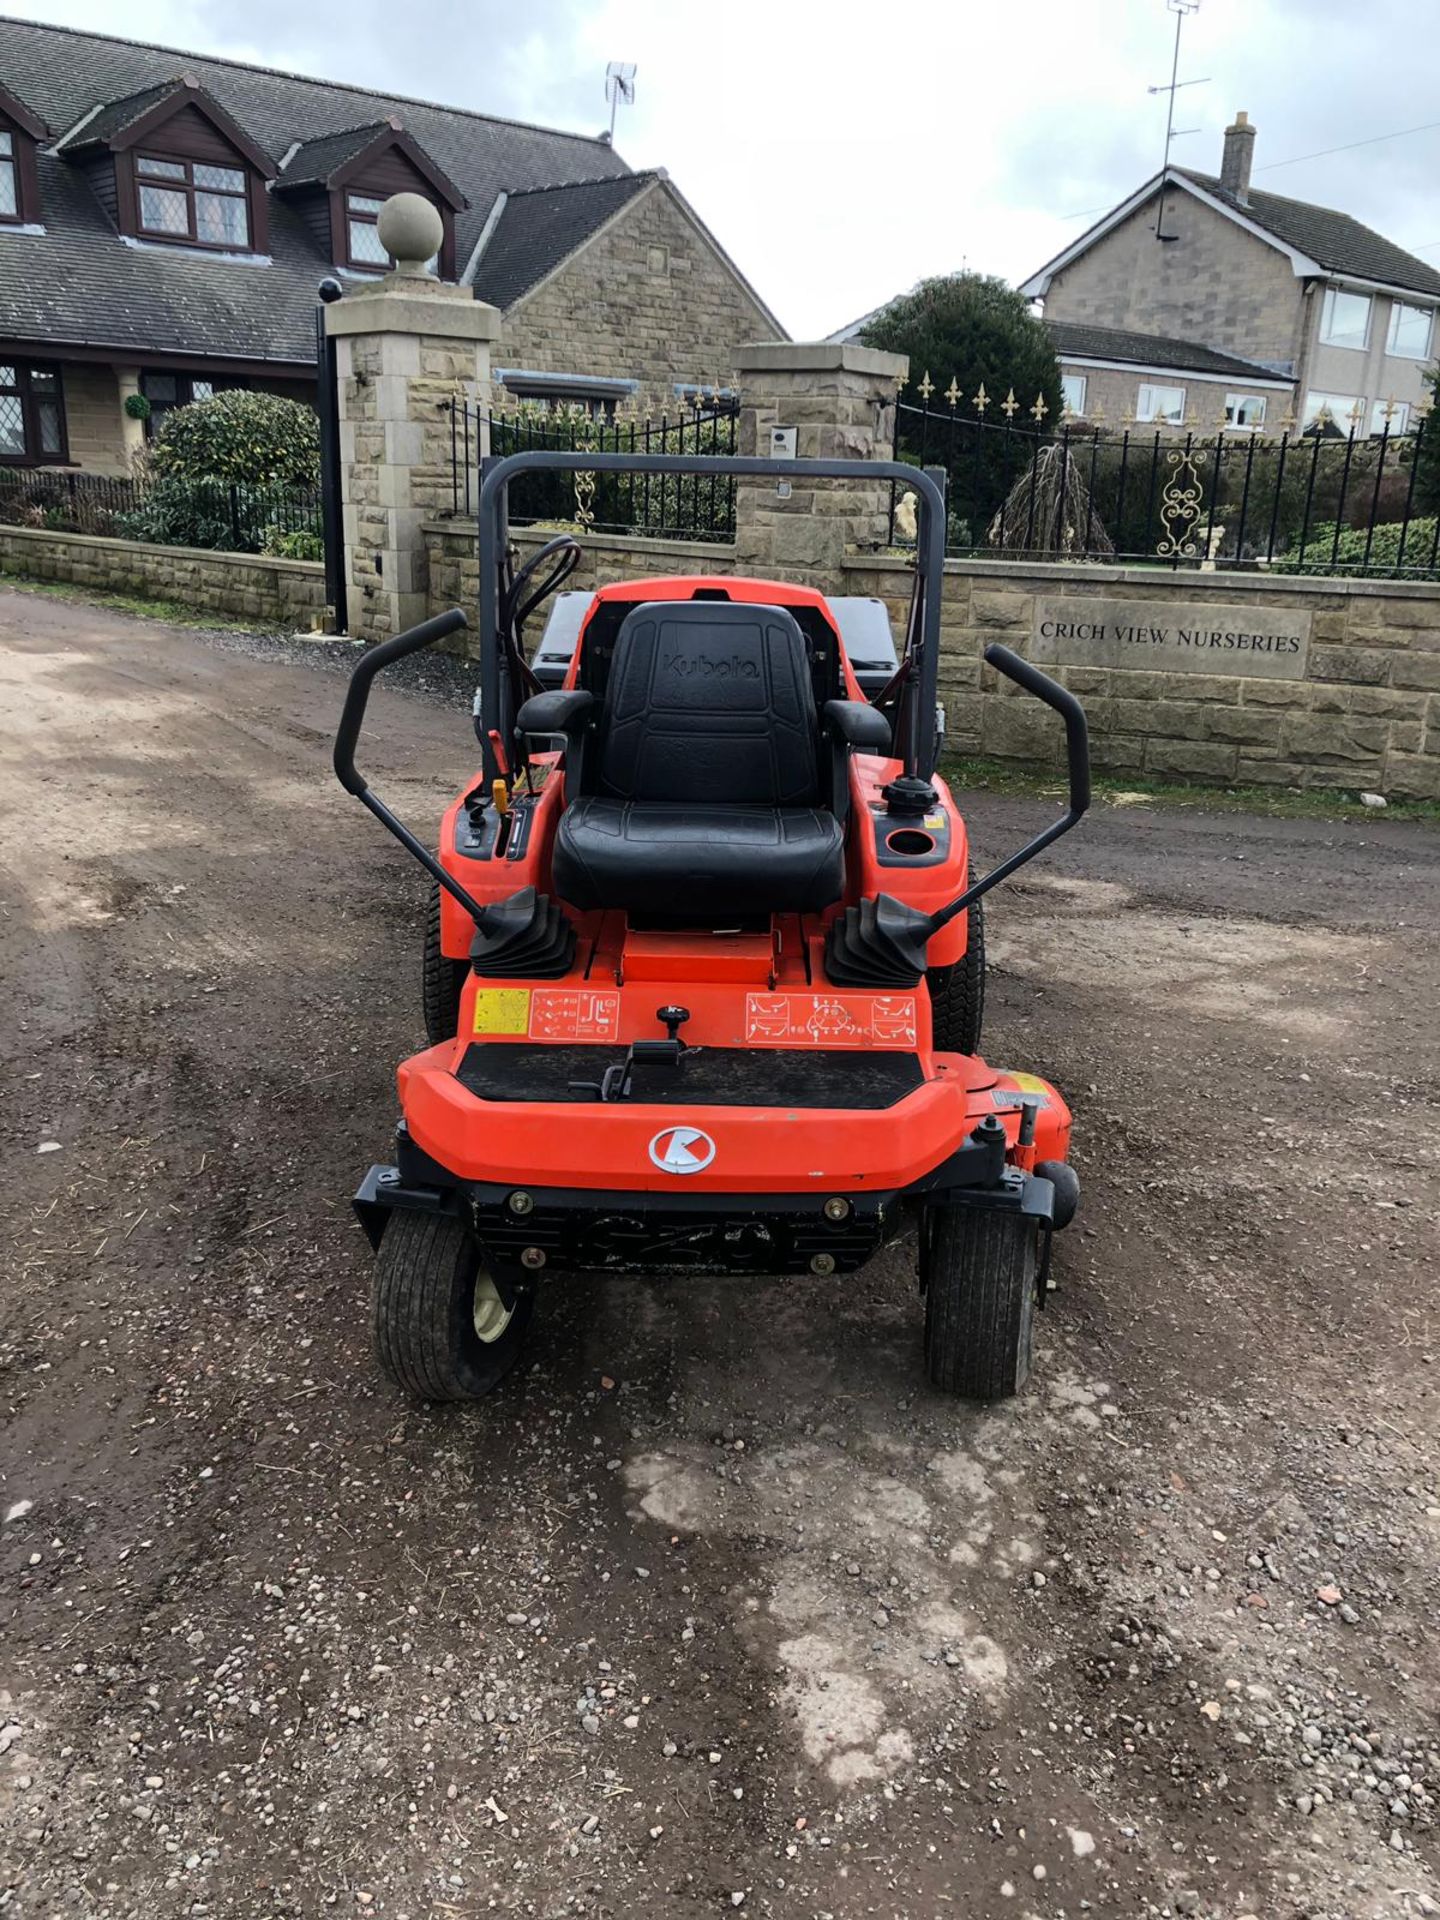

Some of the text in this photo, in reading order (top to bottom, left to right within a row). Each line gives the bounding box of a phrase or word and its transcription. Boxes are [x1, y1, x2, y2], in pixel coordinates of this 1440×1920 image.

[1040, 621, 1301, 654] CRICH VIEW NURSERIES
[663, 653, 761, 681] Kubota
